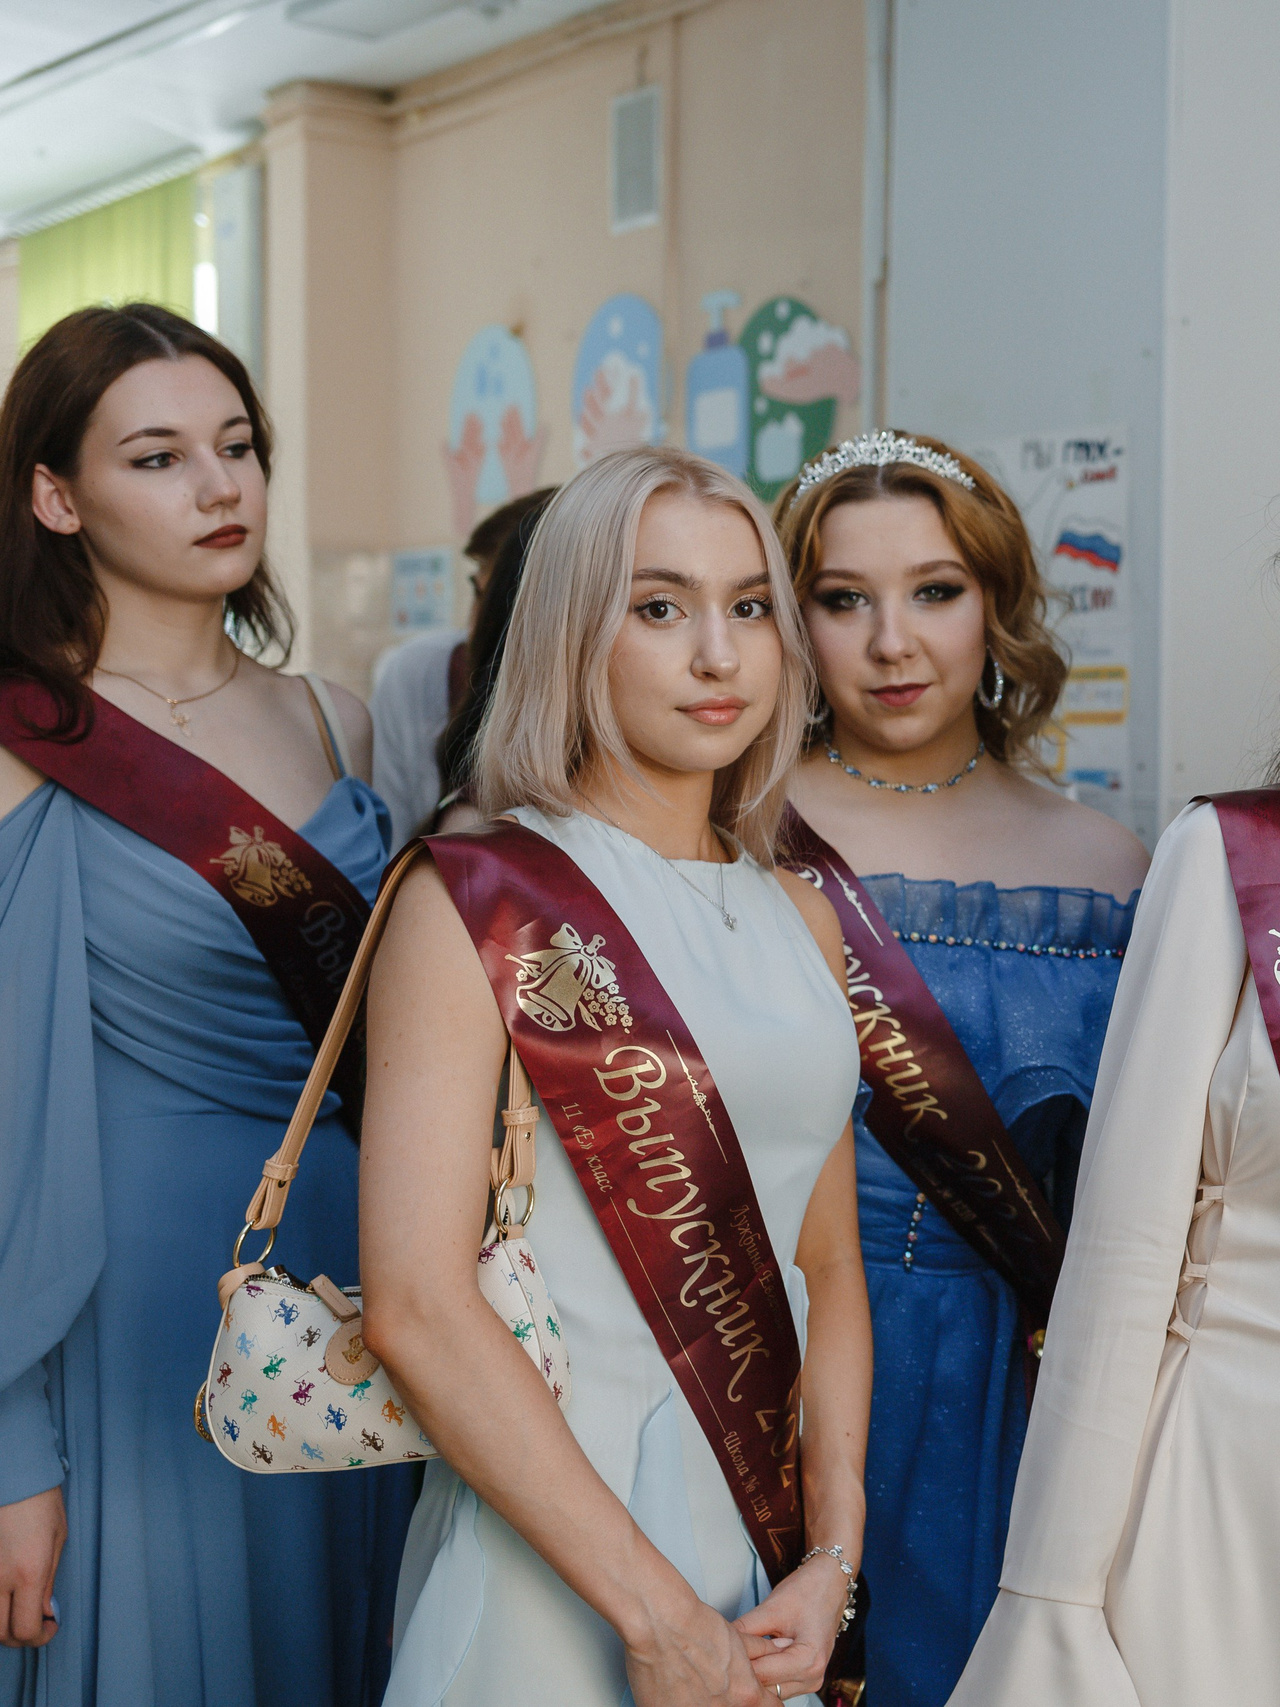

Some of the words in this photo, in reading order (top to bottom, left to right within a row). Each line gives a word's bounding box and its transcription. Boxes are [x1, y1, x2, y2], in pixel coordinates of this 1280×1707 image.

[561, 1102, 584, 1121] 11
[585, 1154, 614, 1194] класс
[592, 1045, 770, 1403] Выпускник
[729, 1204, 765, 1275] Лужбина
[722, 1431, 748, 1477] Школа
[741, 1475, 759, 1494] №
[750, 1497, 772, 1523] 1210
